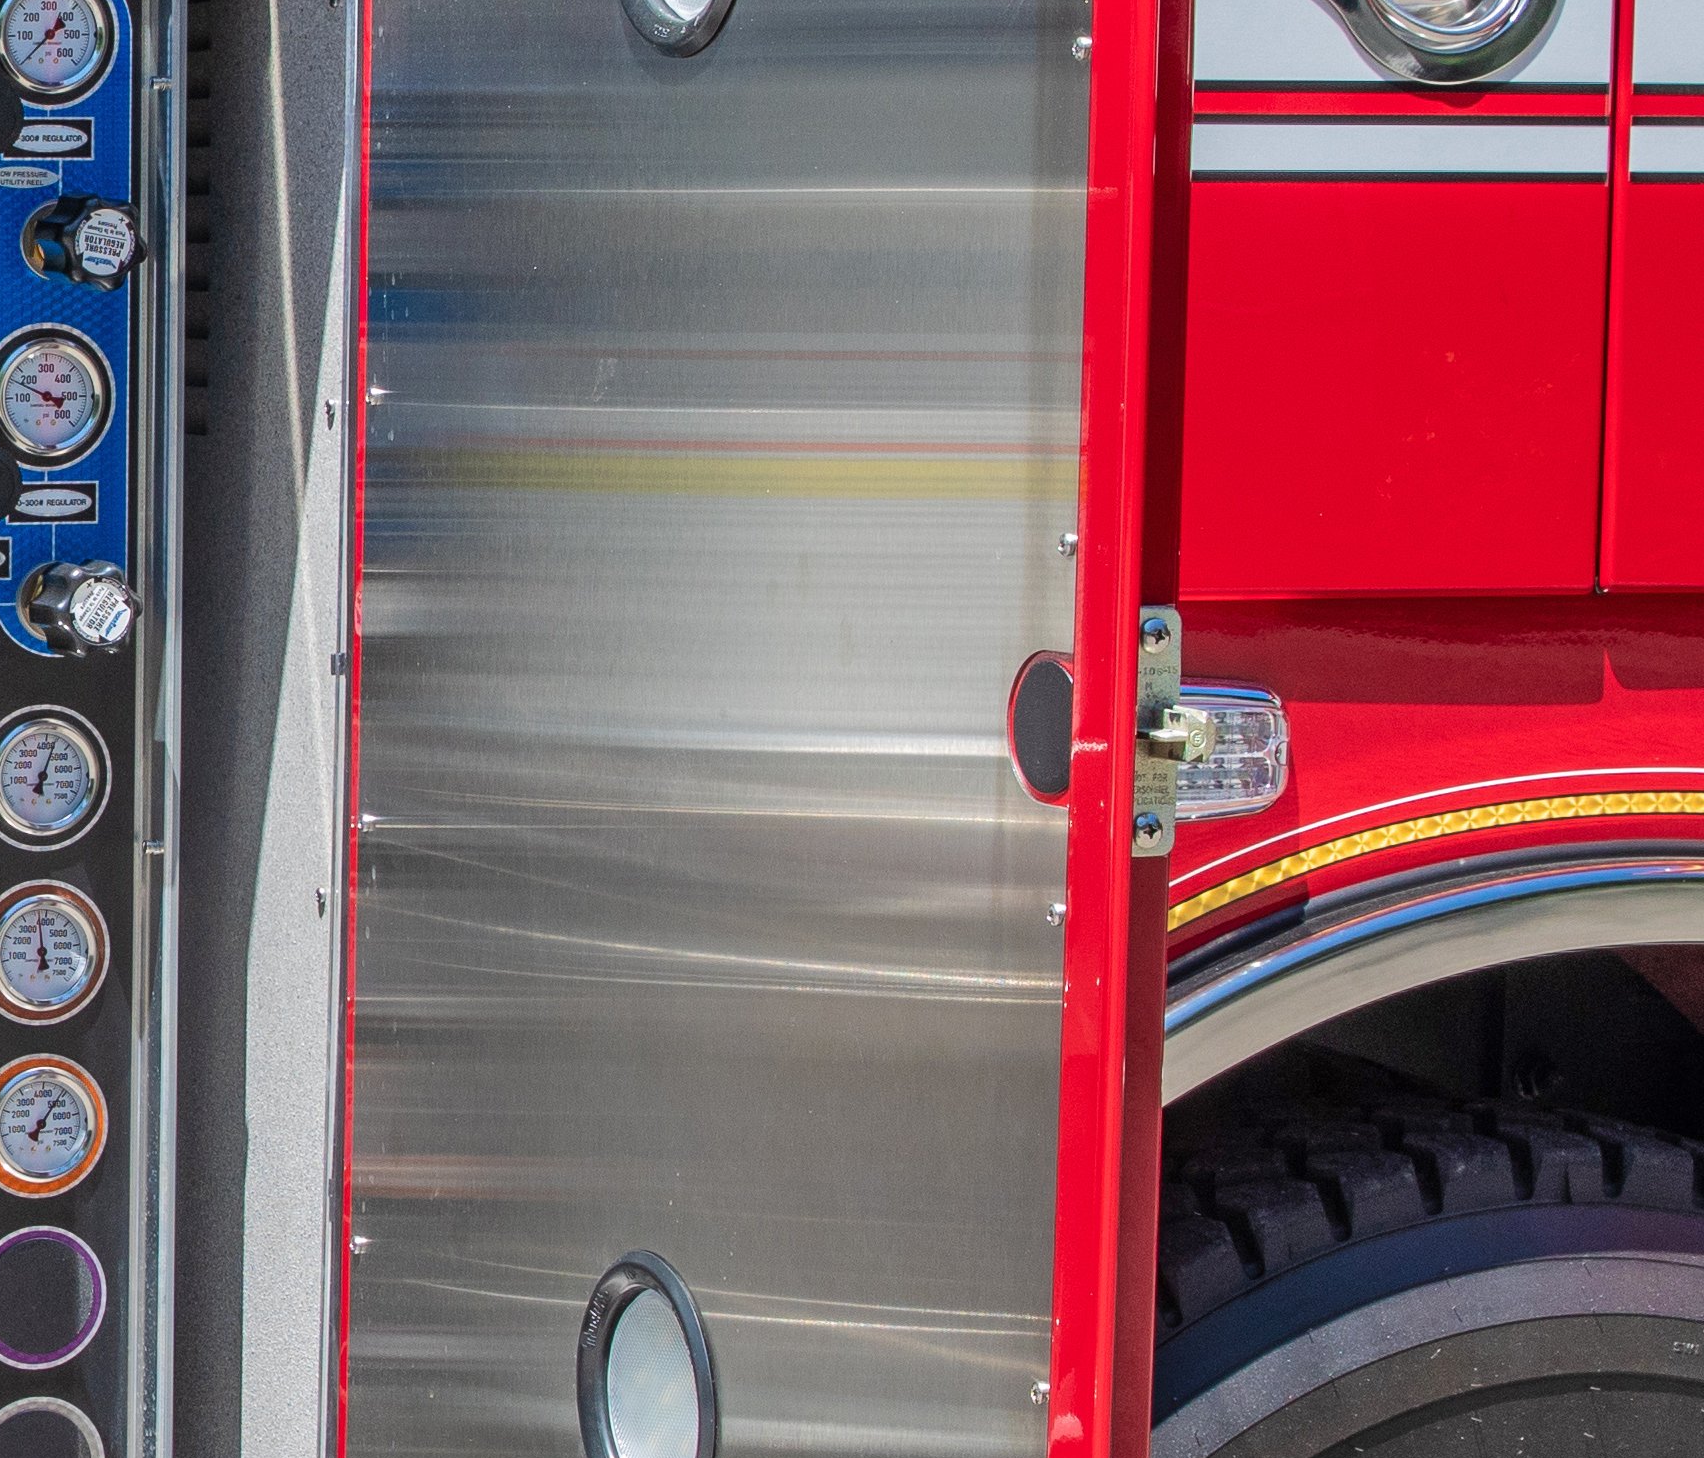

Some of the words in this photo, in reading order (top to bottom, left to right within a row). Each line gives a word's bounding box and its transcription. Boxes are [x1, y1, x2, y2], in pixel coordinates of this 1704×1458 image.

[41, 1, 57, 11] 300
[23, 12, 40, 22] 200
[17, 31, 33, 41] 100
[64, 30, 80, 39] 500
[57, 48, 73, 58] 600
[38, 364, 55, 373] 300
[20, 375, 38, 385] 200
[54, 374, 71, 384] 400
[15, 393, 31, 403] 100
[54, 410, 71, 419] 600
[46, 498, 87, 506] REGULATOR
